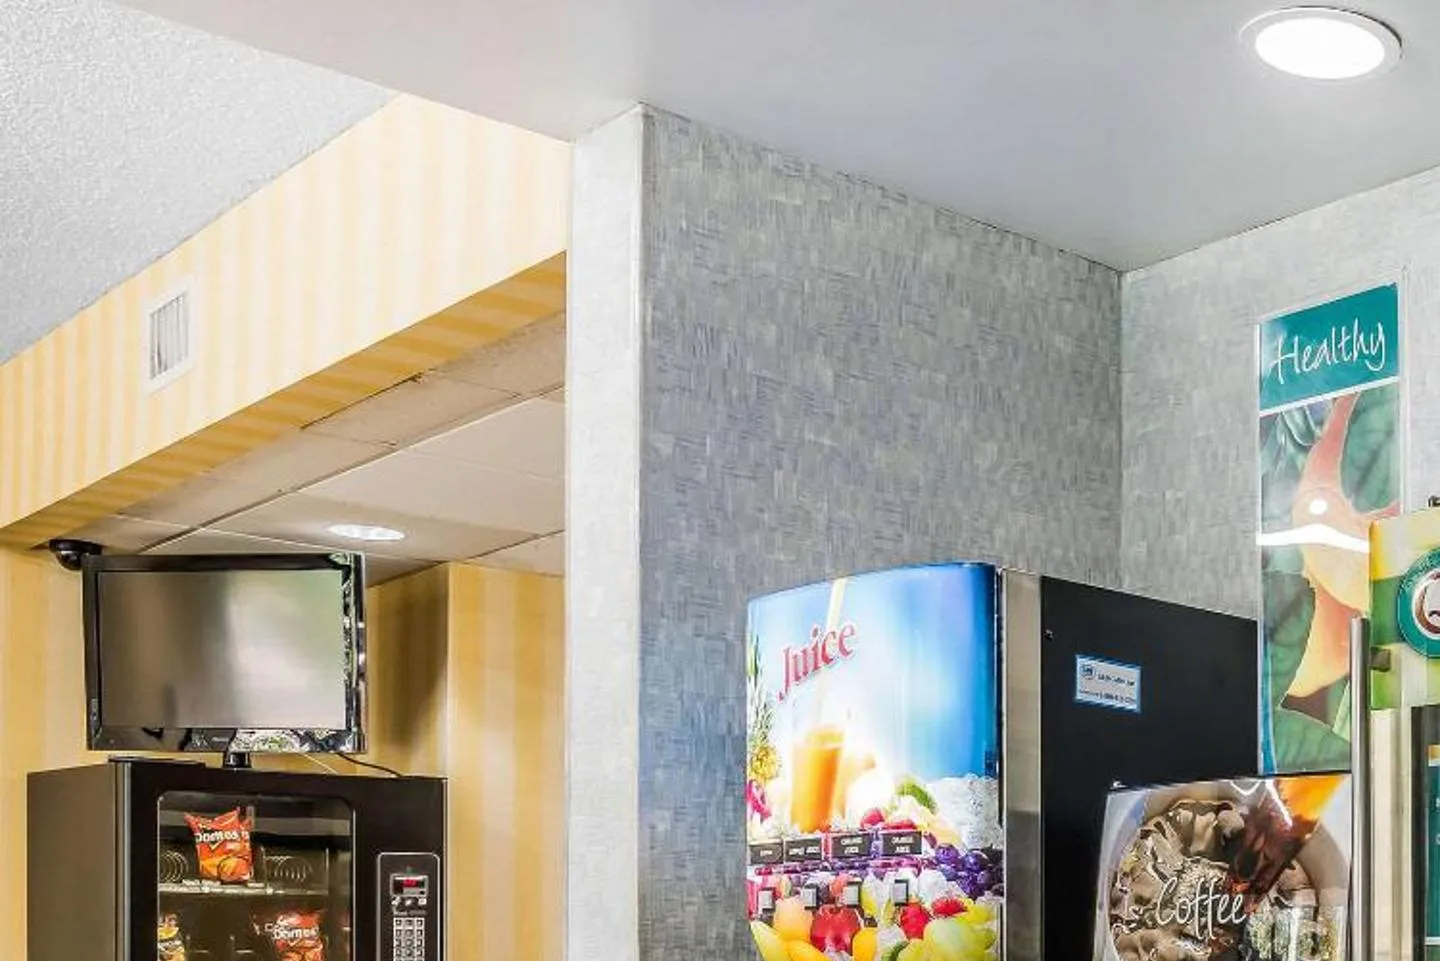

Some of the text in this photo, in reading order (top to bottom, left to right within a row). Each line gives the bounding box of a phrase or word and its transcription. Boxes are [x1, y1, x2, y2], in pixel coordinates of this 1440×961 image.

[1268, 317, 1386, 385] Healthy
[778, 623, 856, 702] Juice
[1156, 876, 1247, 940] Coffee
